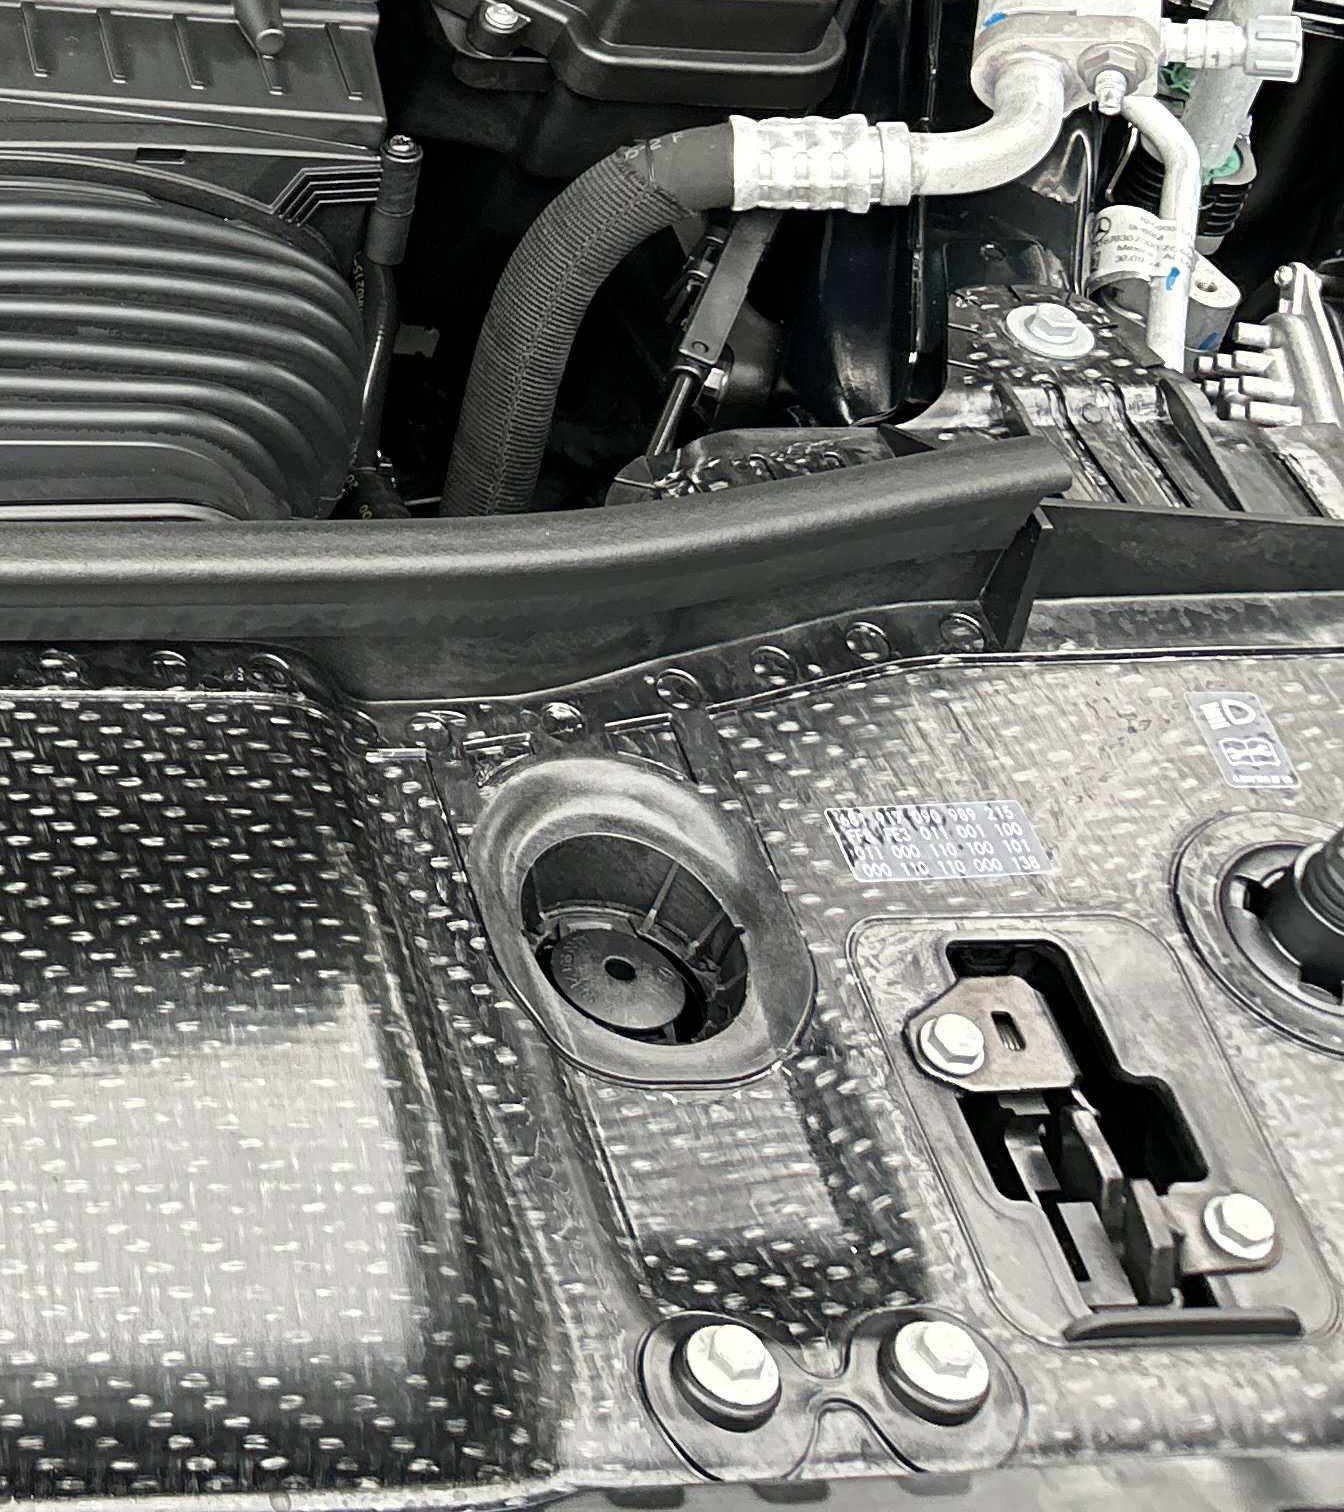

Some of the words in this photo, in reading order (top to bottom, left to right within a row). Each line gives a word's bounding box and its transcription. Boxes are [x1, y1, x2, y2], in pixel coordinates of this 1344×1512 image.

[911, 809, 940, 823] 090
[948, 808, 976, 821] 989
[985, 806, 1014, 819] 215
[920, 826, 947, 839] 011
[956, 824, 984, 838] 001
[995, 822, 1022, 836] 100
[855, 846, 881, 860] 011
[892, 844, 920, 858] 000
[930, 843, 956, 856] 110
[968, 841, 994, 854] 100
[1004, 839, 1029, 852] 101
[863, 864, 891, 877] 000
[902, 862, 928, 875] 110
[939, 860, 965, 873] 110
[973, 858, 1002, 871] 000
[1012, 856, 1039, 869] 138
